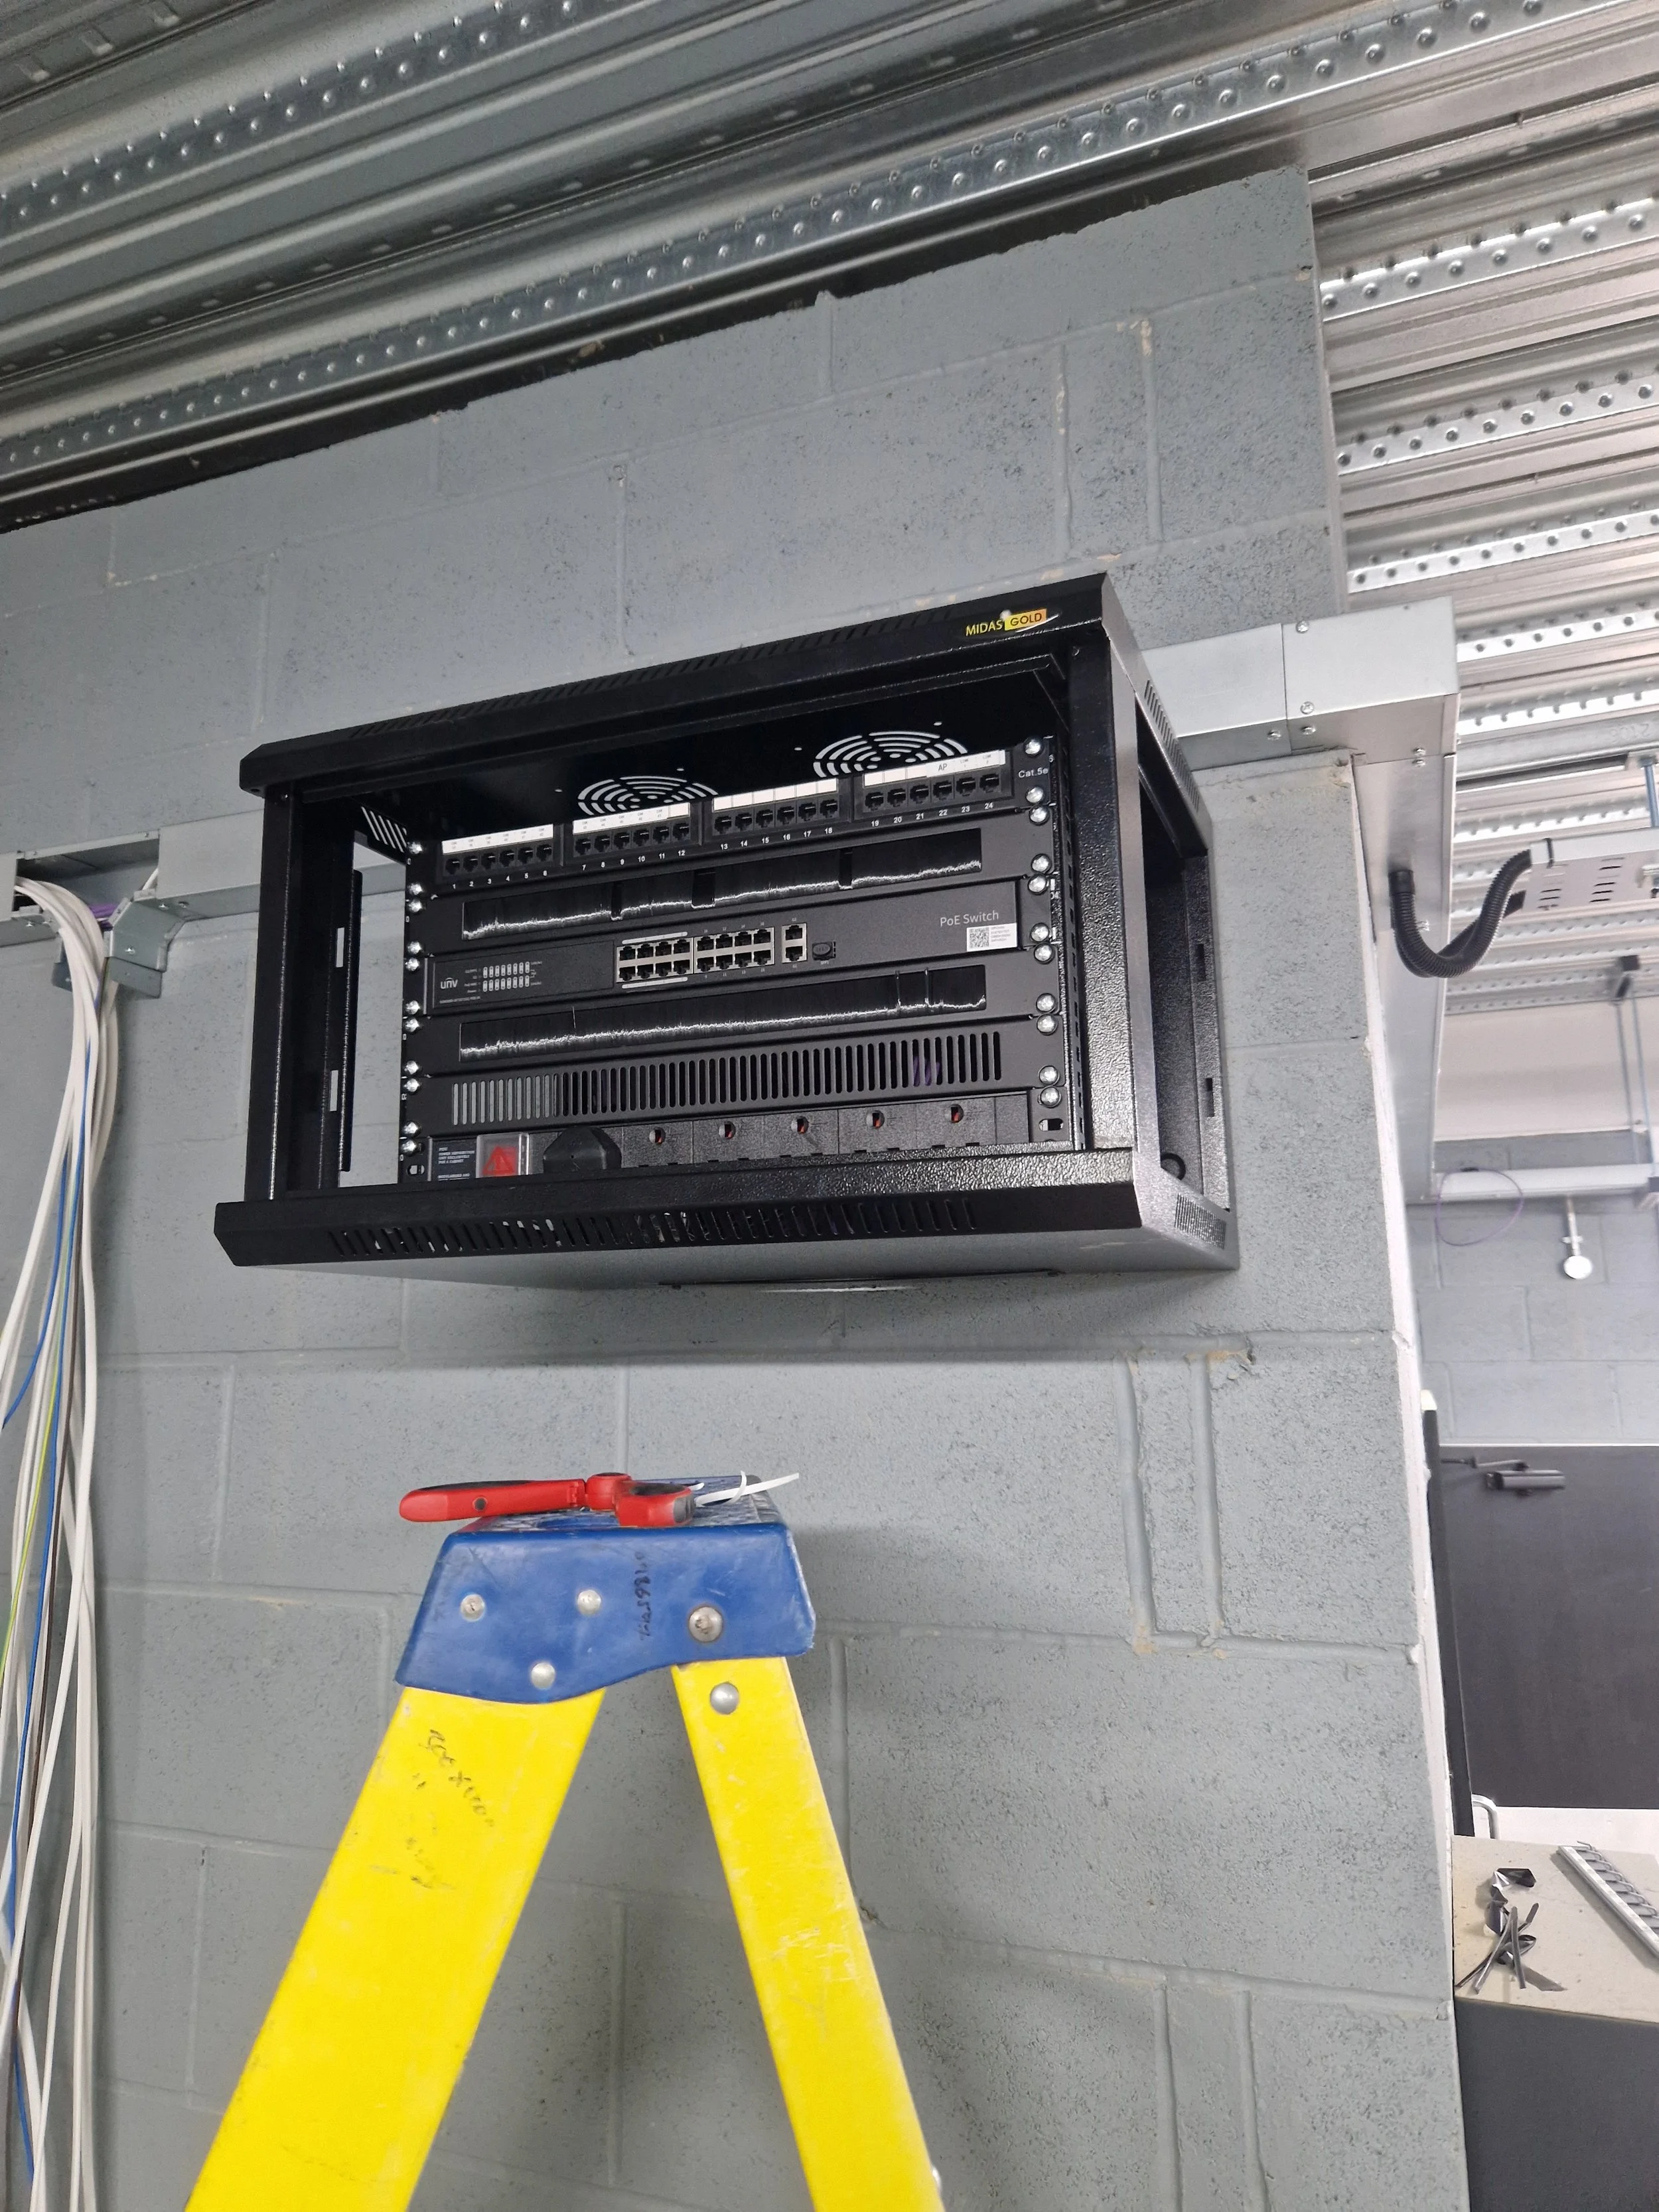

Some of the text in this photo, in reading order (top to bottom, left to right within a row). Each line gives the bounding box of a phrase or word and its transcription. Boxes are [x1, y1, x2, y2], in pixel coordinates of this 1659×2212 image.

[966, 612, 1043, 636] MIDAS GOLD
[938, 763, 948, 772] AP
[1018, 767, 1048, 778] Cat.5e
[940, 910, 999, 927] PoE Switch
